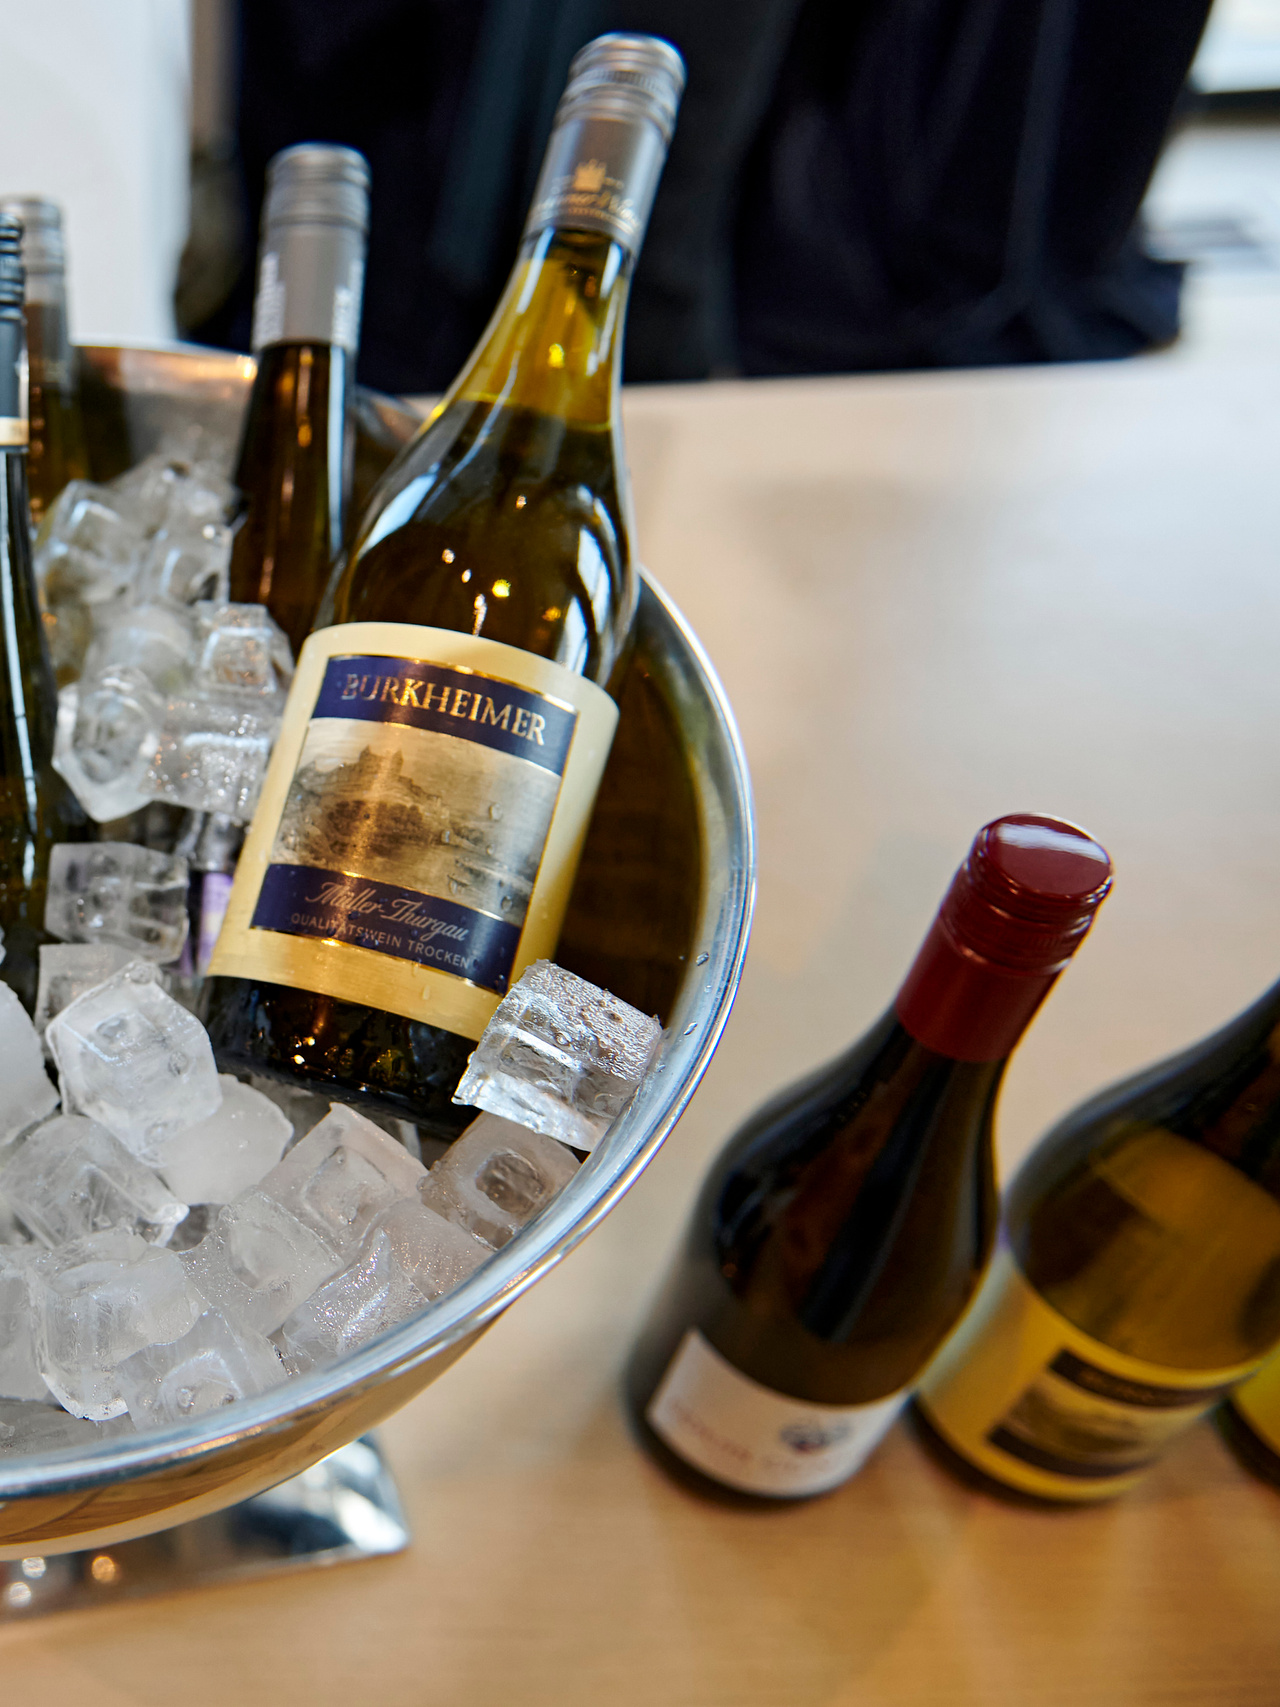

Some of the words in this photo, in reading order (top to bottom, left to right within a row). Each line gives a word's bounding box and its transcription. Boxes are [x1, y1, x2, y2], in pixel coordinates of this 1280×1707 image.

[341, 673, 547, 747] BURKHEIMER
[304, 881, 470, 943] Müller-Thurgau
[407, 938, 471, 971] TROCKEN
